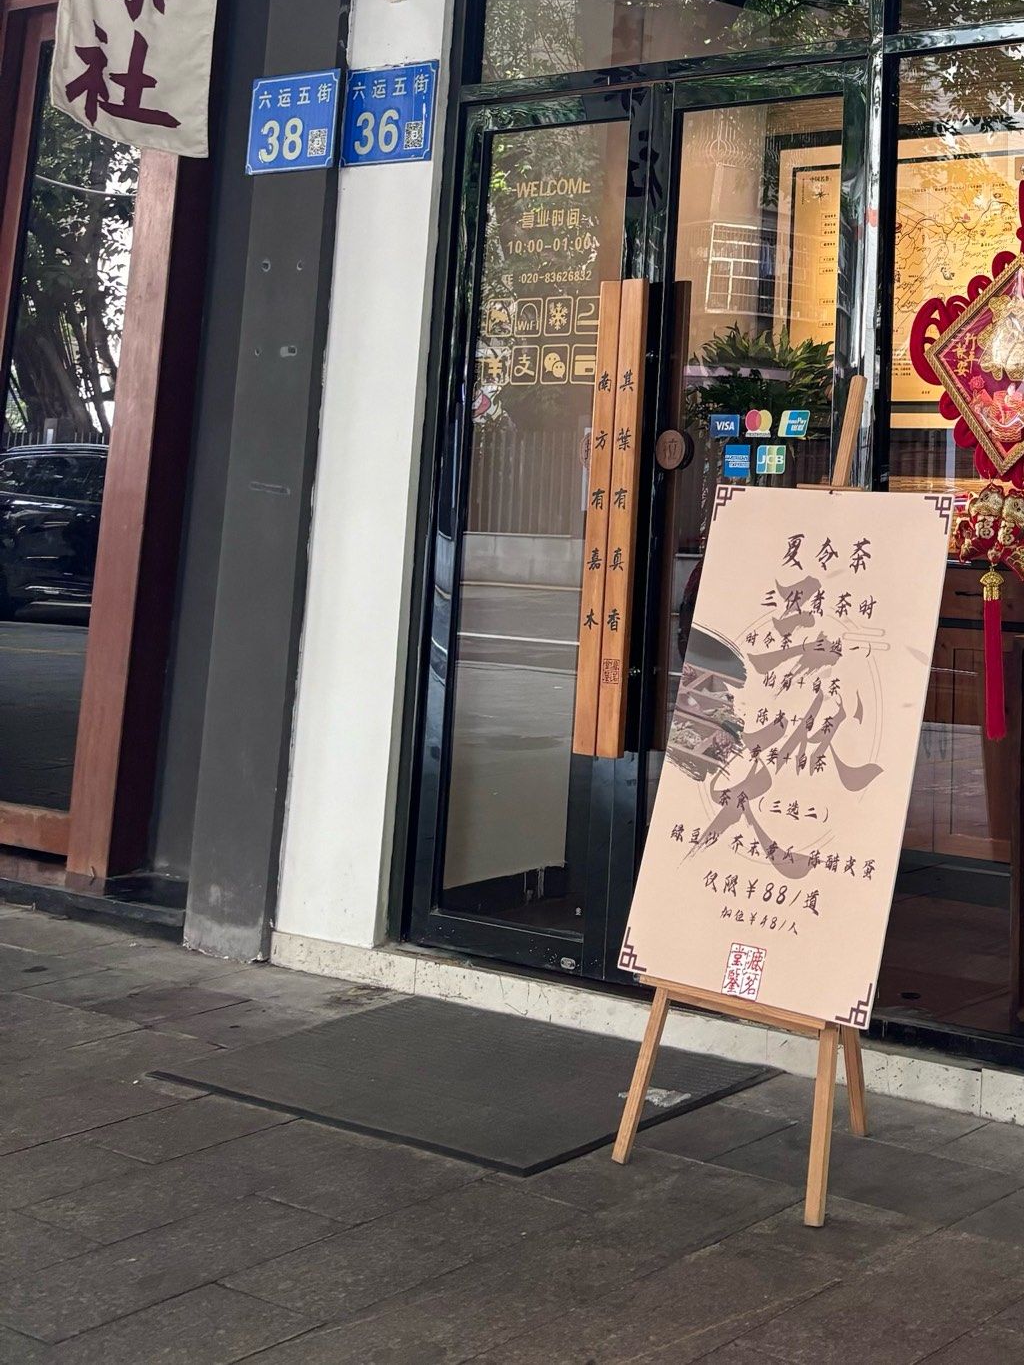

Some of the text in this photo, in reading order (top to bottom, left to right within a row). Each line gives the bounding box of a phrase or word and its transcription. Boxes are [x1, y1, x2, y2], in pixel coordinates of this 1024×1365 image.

[258, 83, 332, 109] 六运五街
[352, 73, 429, 101] 六运五街
[259, 117, 303, 163] 38
[354, 109, 399, 156] 36
[516, 177, 591, 199] WELCOME
[521, 208, 580, 230] 营业时间
[508, 236, 592, 255] 10:00-01:00
[715, 421, 735, 431] VISA
[757, 455, 784, 465] JCB
[583, 370, 613, 631] 南方有嘉木
[782, 533, 871, 574] 夏令茶
[760, 589, 877, 620] 三伏煮茶时
[670, 824, 720, 848] 绿豆沙
[808, 849, 876, 880] 陈醋皮蛋
